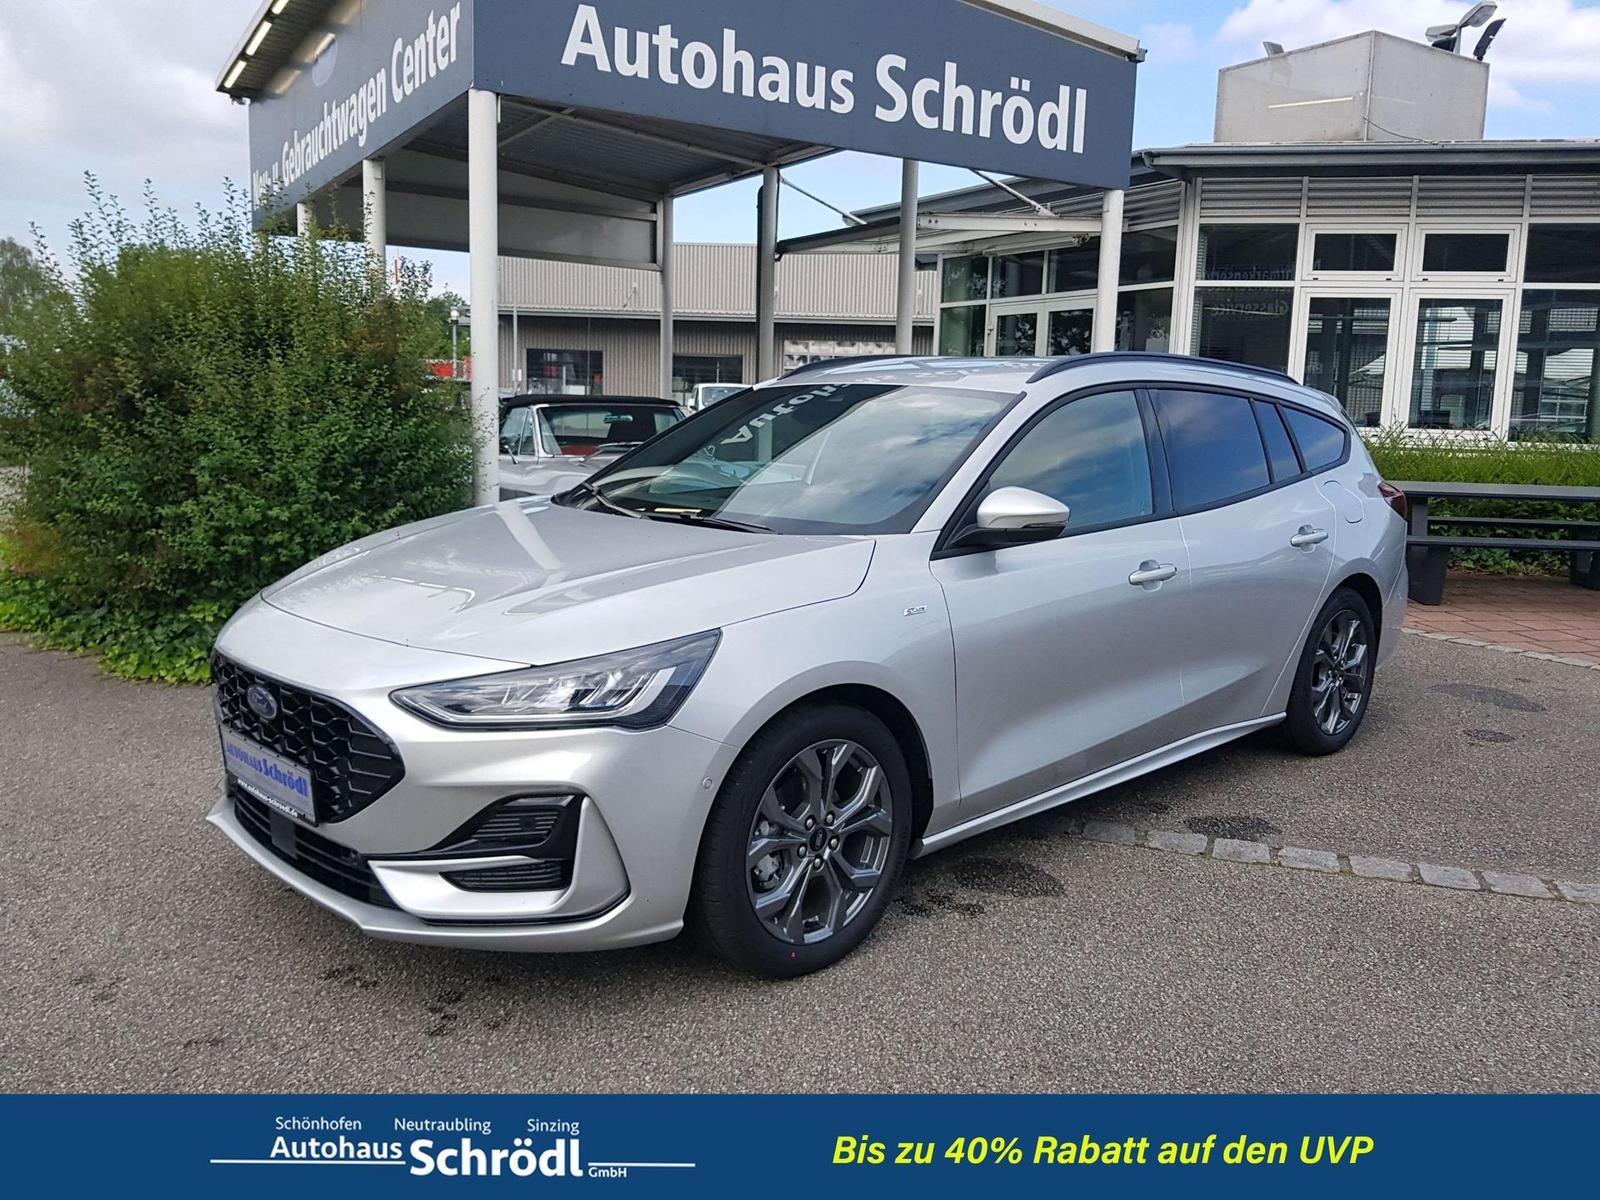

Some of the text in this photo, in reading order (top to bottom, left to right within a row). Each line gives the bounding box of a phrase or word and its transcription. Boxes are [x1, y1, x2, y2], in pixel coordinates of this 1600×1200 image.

[281, 67, 388, 189] Gebrauchtwagen
[391, 1, 461, 105] Center
[560, 3, 1088, 155] Autohaus Schrödl
[262, 757, 309, 797] Schrödl
